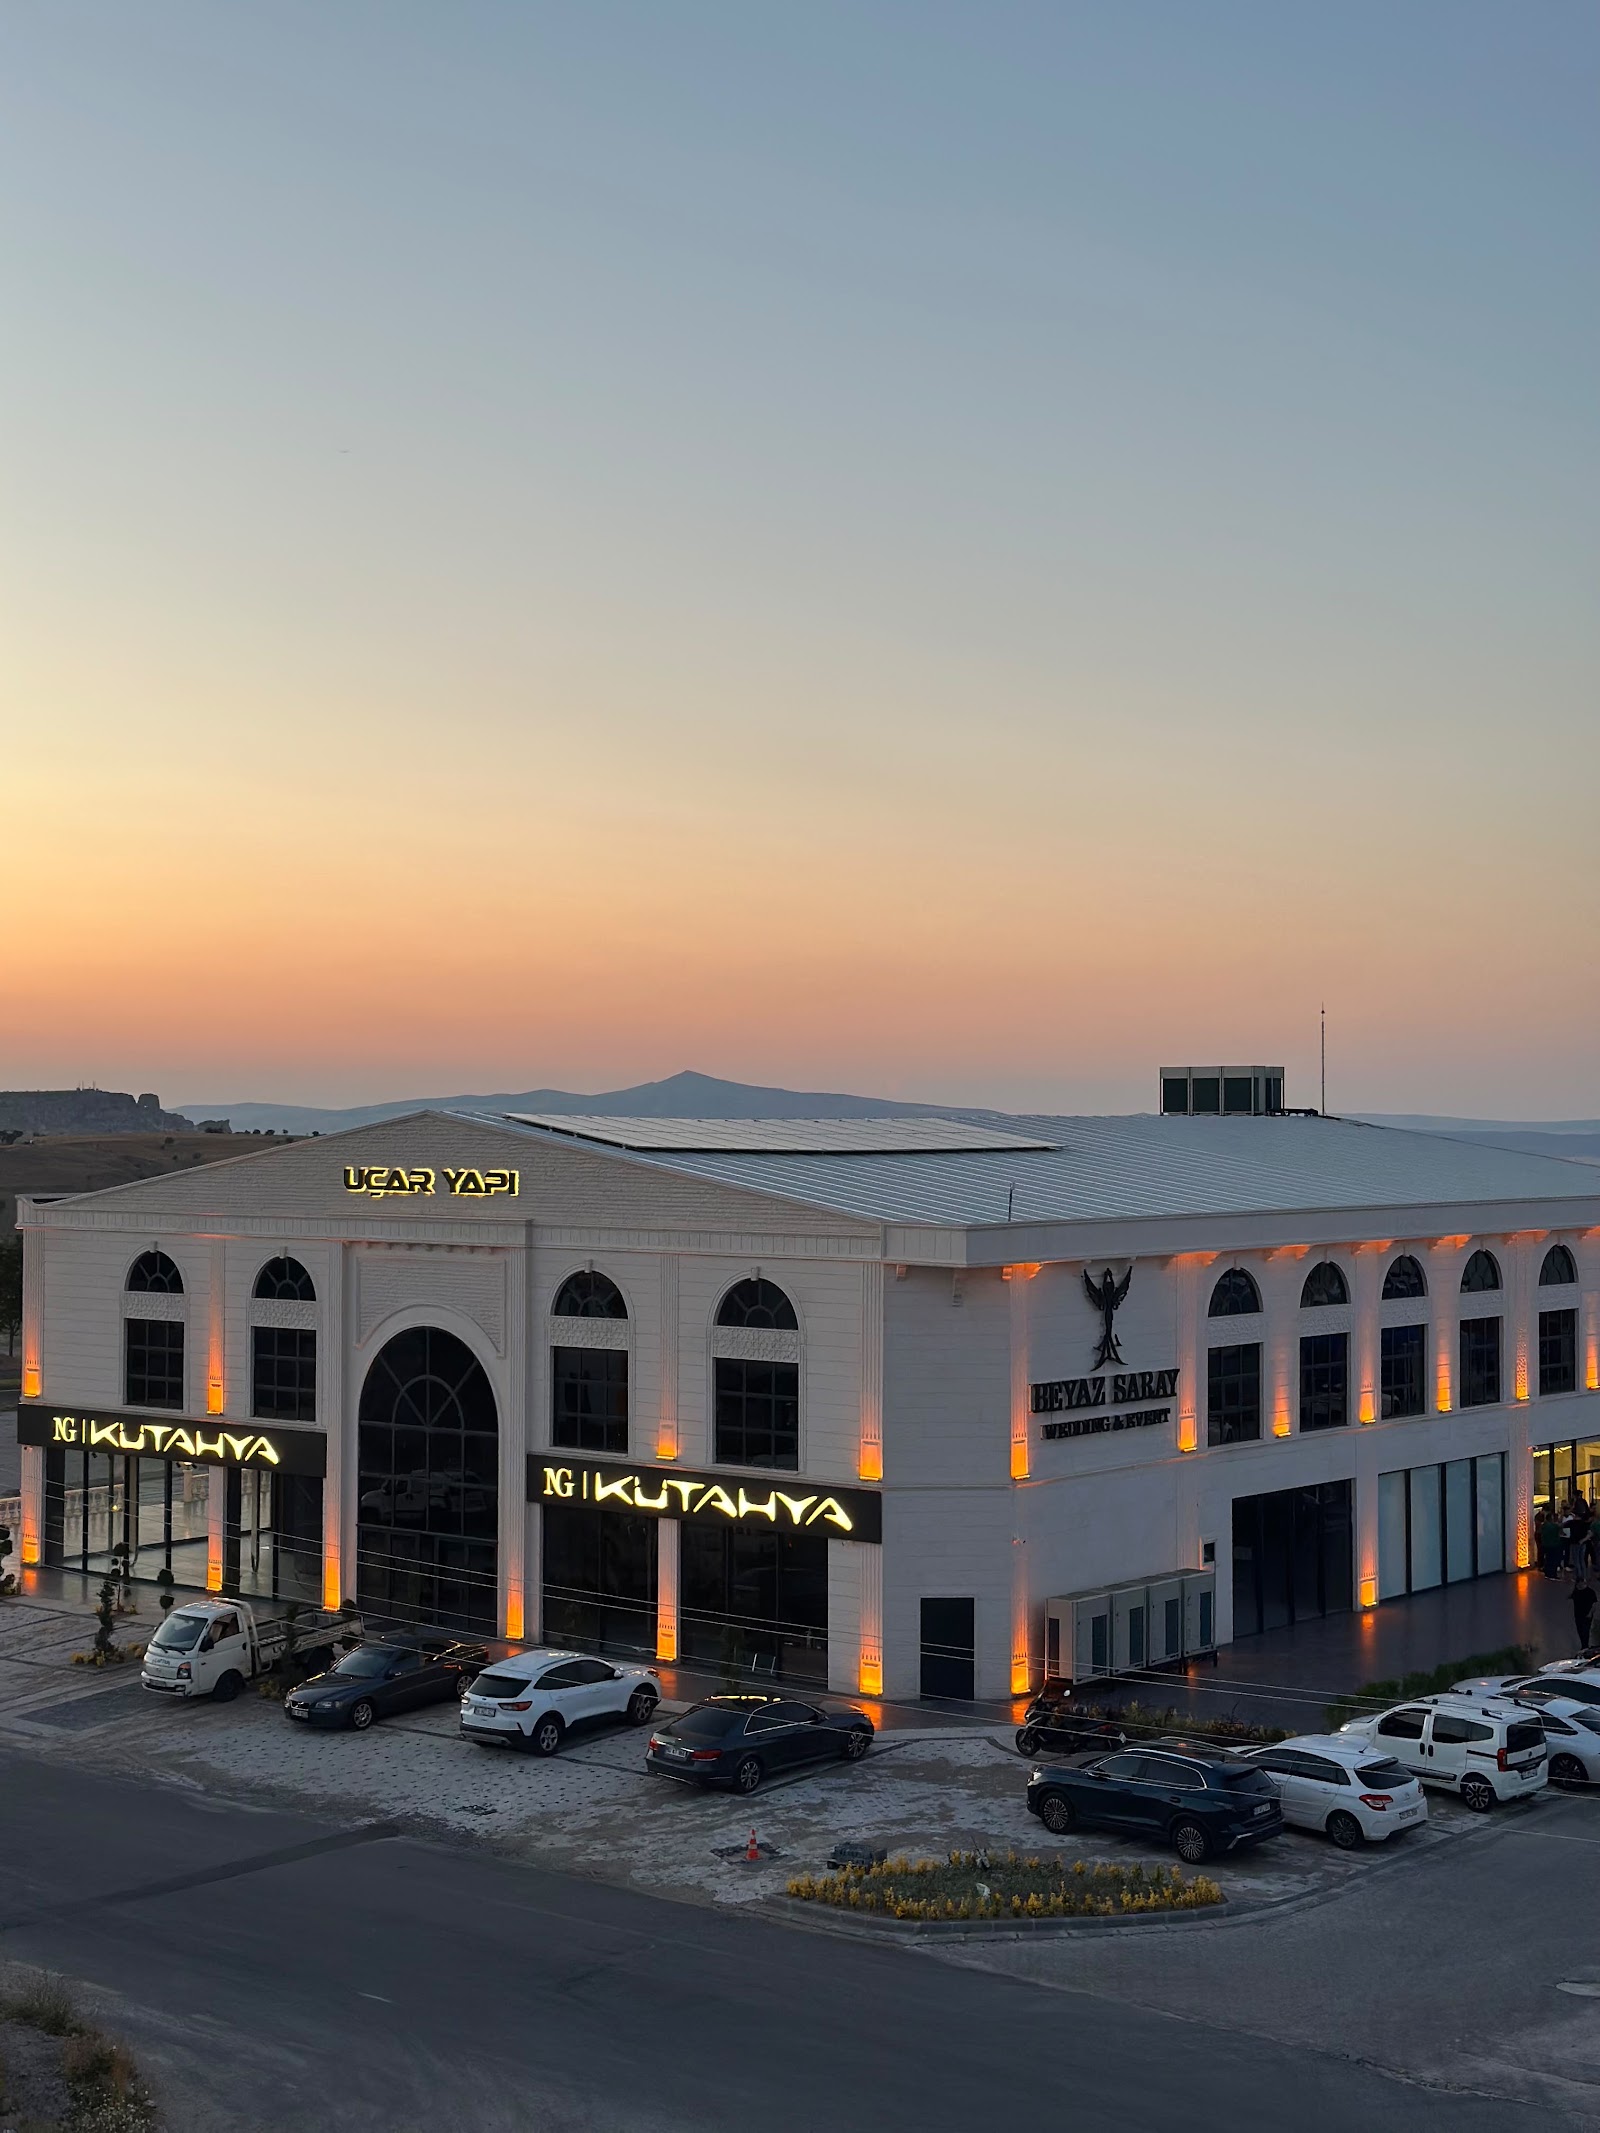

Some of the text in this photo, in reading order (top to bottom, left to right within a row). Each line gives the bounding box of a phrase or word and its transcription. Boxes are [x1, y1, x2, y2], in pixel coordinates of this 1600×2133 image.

[343, 1167, 520, 1199] UÇAR YAPI
[1029, 1369, 1181, 1413] BEYAZ SARAY
[53, 1416, 76, 1443] NG
[1041, 1408, 1171, 1440] WEDDING & EVENT
[543, 1467, 576, 1498] NG
